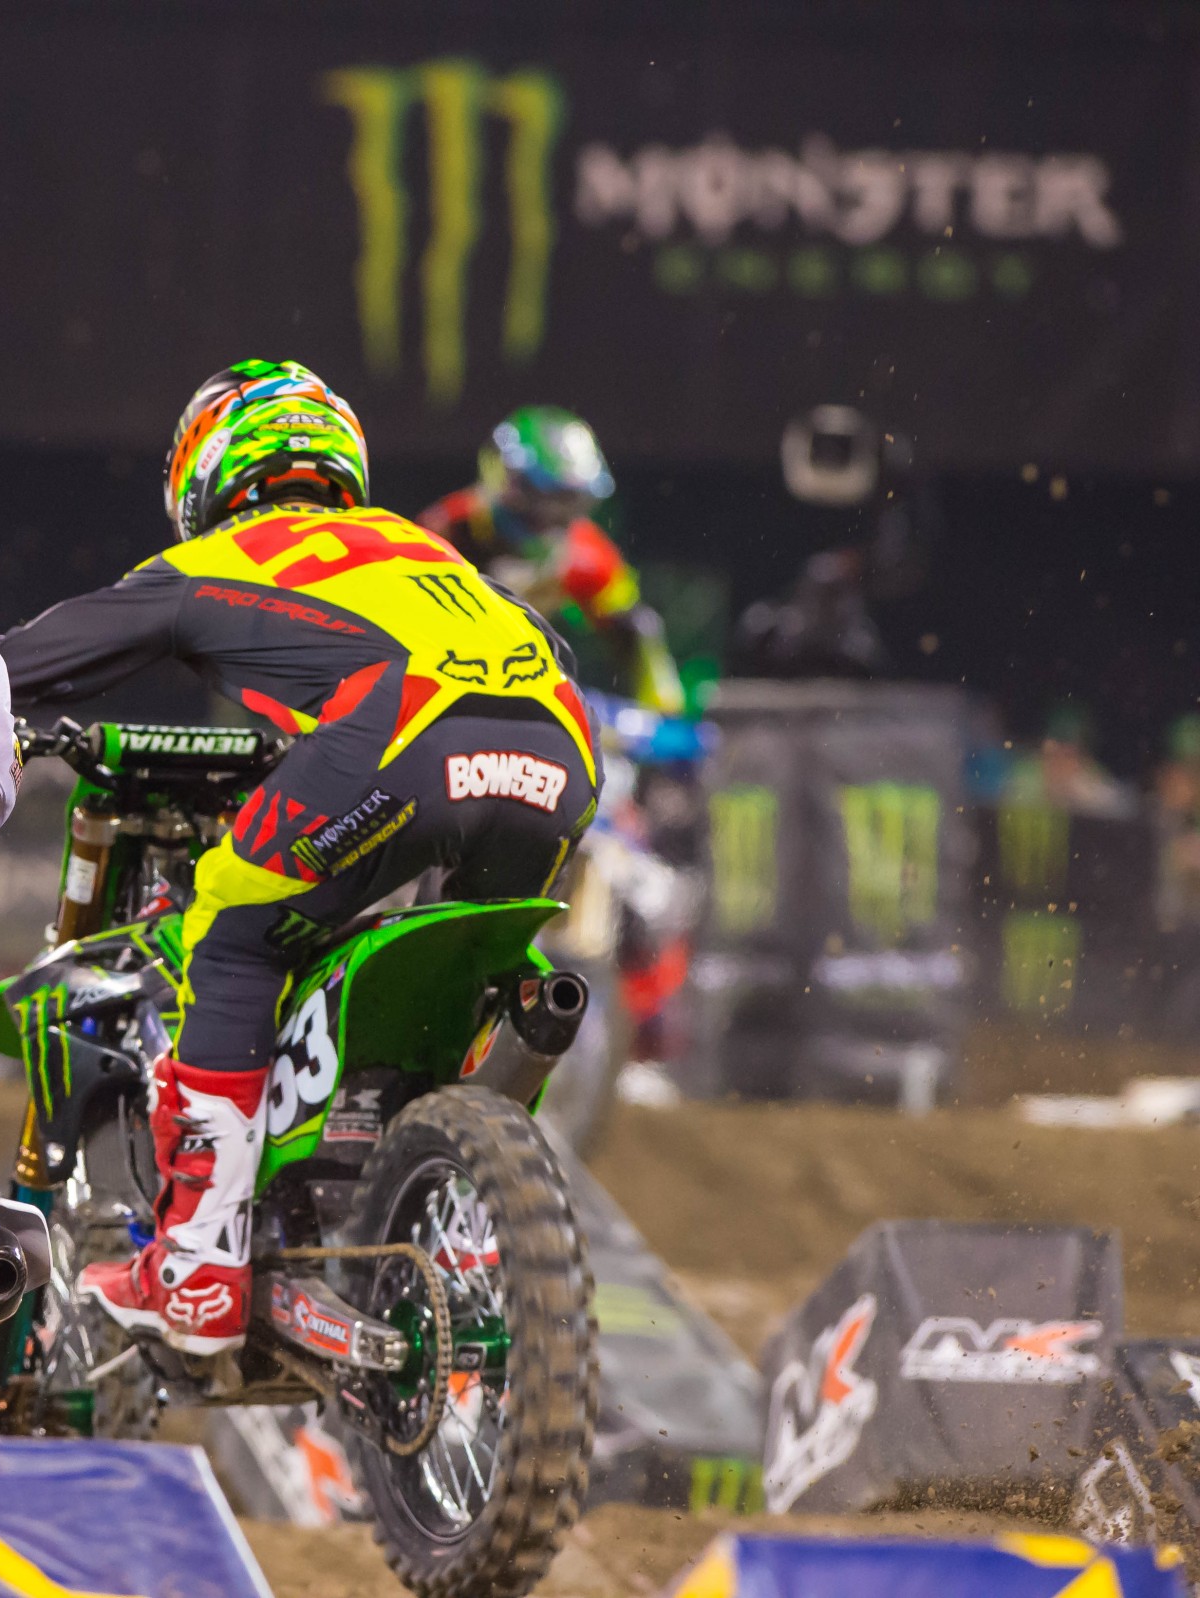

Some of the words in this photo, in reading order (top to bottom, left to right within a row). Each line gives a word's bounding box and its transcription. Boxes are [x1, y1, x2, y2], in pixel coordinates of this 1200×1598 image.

[574, 134, 1122, 247] MONSTER
[200, 437, 225, 471] BELL
[447, 752, 567, 813] BOWSER
[311, 789, 390, 852] MONSTER
